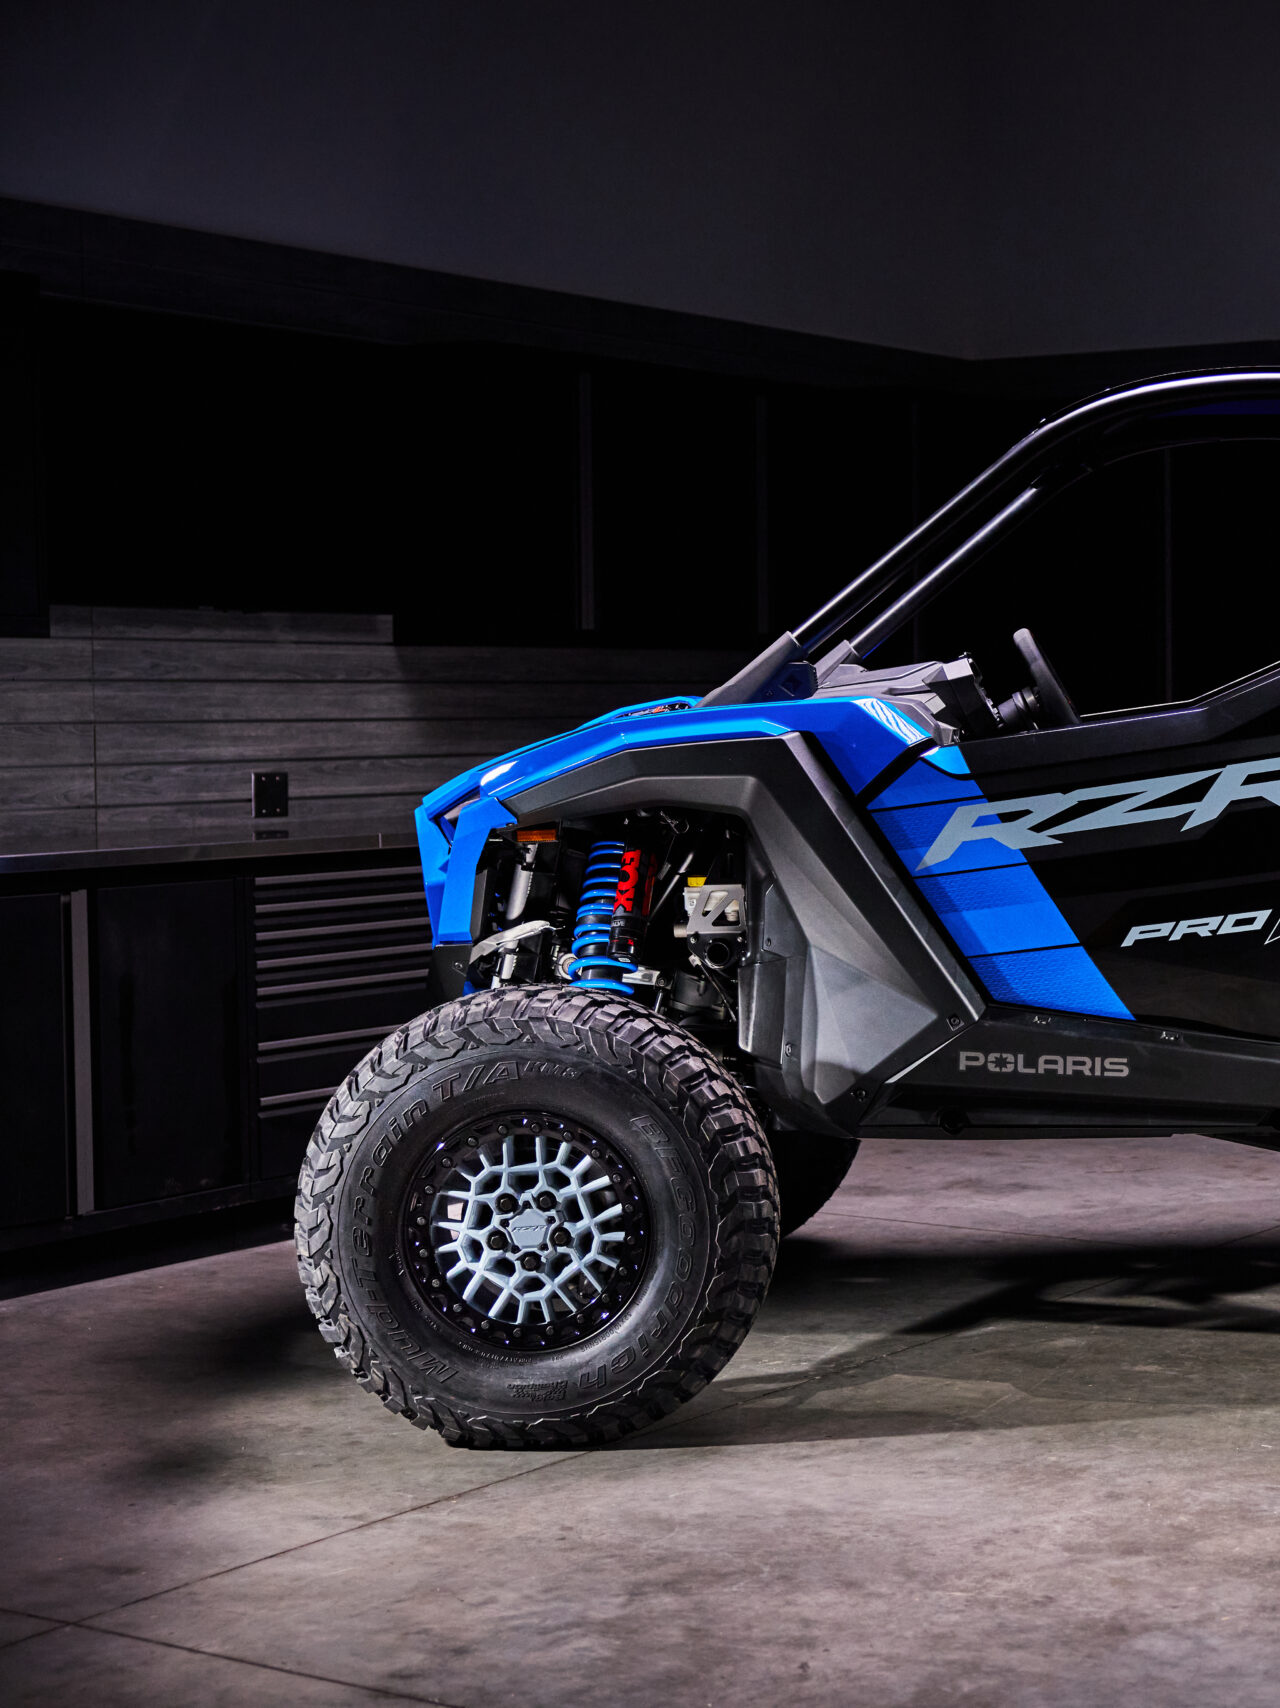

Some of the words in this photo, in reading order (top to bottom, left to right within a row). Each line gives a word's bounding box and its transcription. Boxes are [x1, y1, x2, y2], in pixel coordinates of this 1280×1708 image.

[613, 849, 641, 912] FOX
[1120, 910, 1272, 948] PRO
[959, 1051, 1129, 1077] POLARIS
[352, 1099, 459, 1384] Mud-Terrain
[431, 1058, 520, 1100] T/A
[580, 1113, 697, 1388] BFGoodrich
